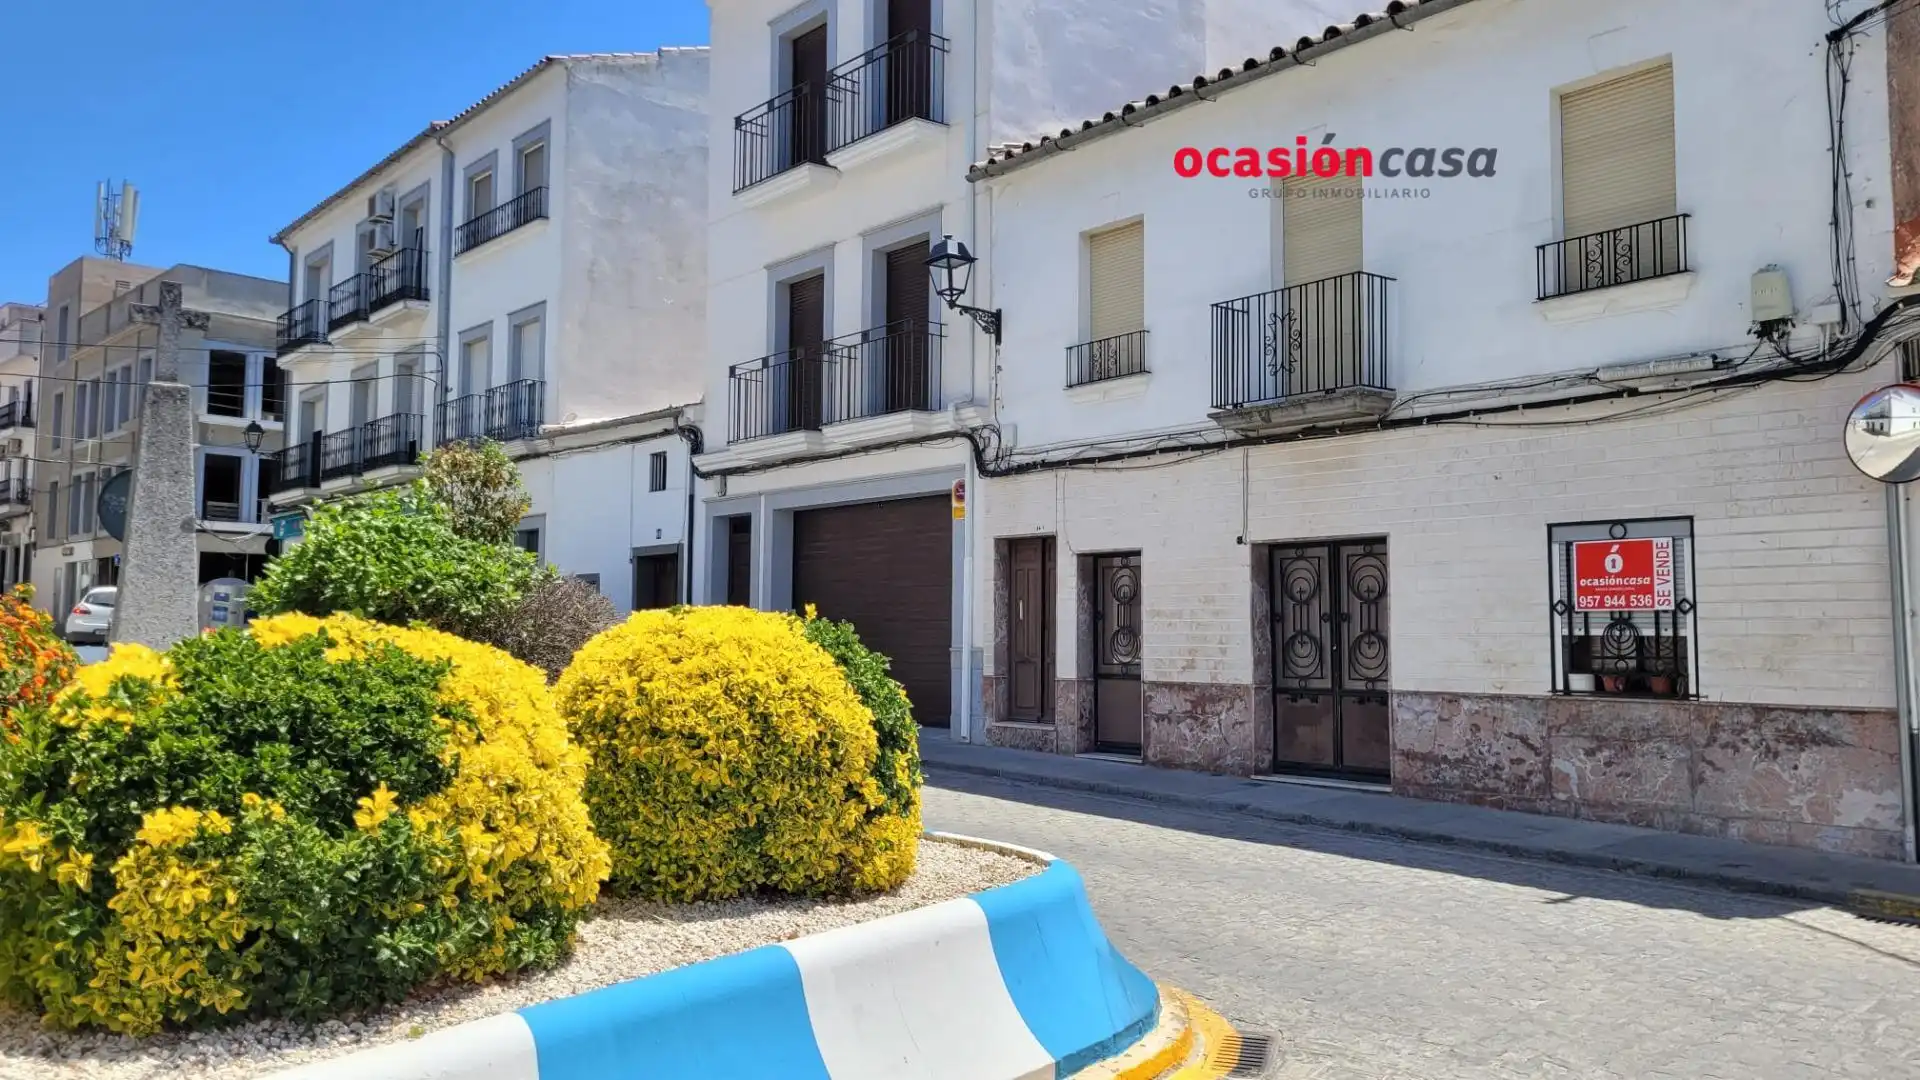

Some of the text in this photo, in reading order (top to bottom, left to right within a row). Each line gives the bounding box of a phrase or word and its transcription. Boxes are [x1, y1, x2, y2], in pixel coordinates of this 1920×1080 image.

[1655, 541, 1671, 607] SE VENDE
[1579, 593, 1653, 608] 957 944 536
